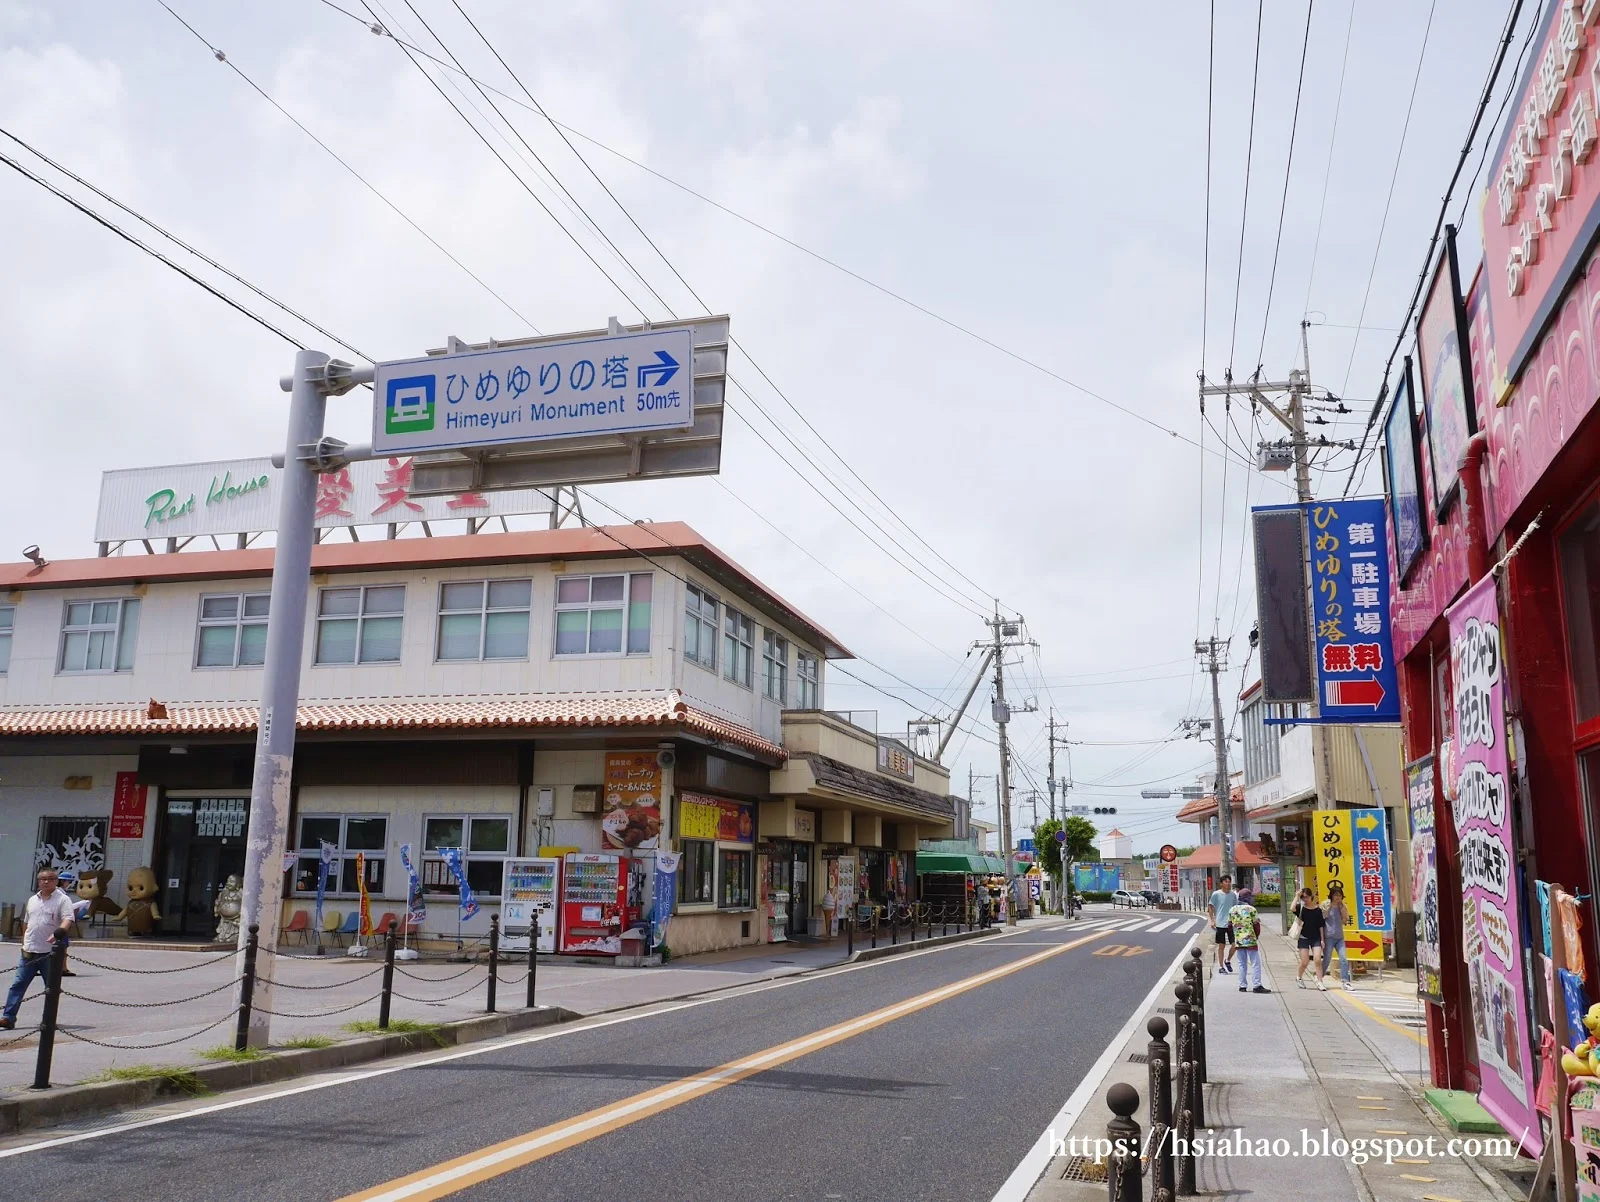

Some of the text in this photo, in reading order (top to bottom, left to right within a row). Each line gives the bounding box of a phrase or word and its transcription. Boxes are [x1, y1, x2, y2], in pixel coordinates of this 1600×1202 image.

[446, 355, 630, 404] ひめゆりの塔
[636, 390, 681, 412] 50m先
[446, 398, 625, 430] Himeyuri Monument
[144, 470, 269, 529] Rest House
[1313, 506, 1347, 642] ひめゆりの塔
[1347, 522, 1382, 635] 第一駐車場
[1322, 642, 1383, 672] 無料
[1359, 839, 1385, 926] 無料駐車場
